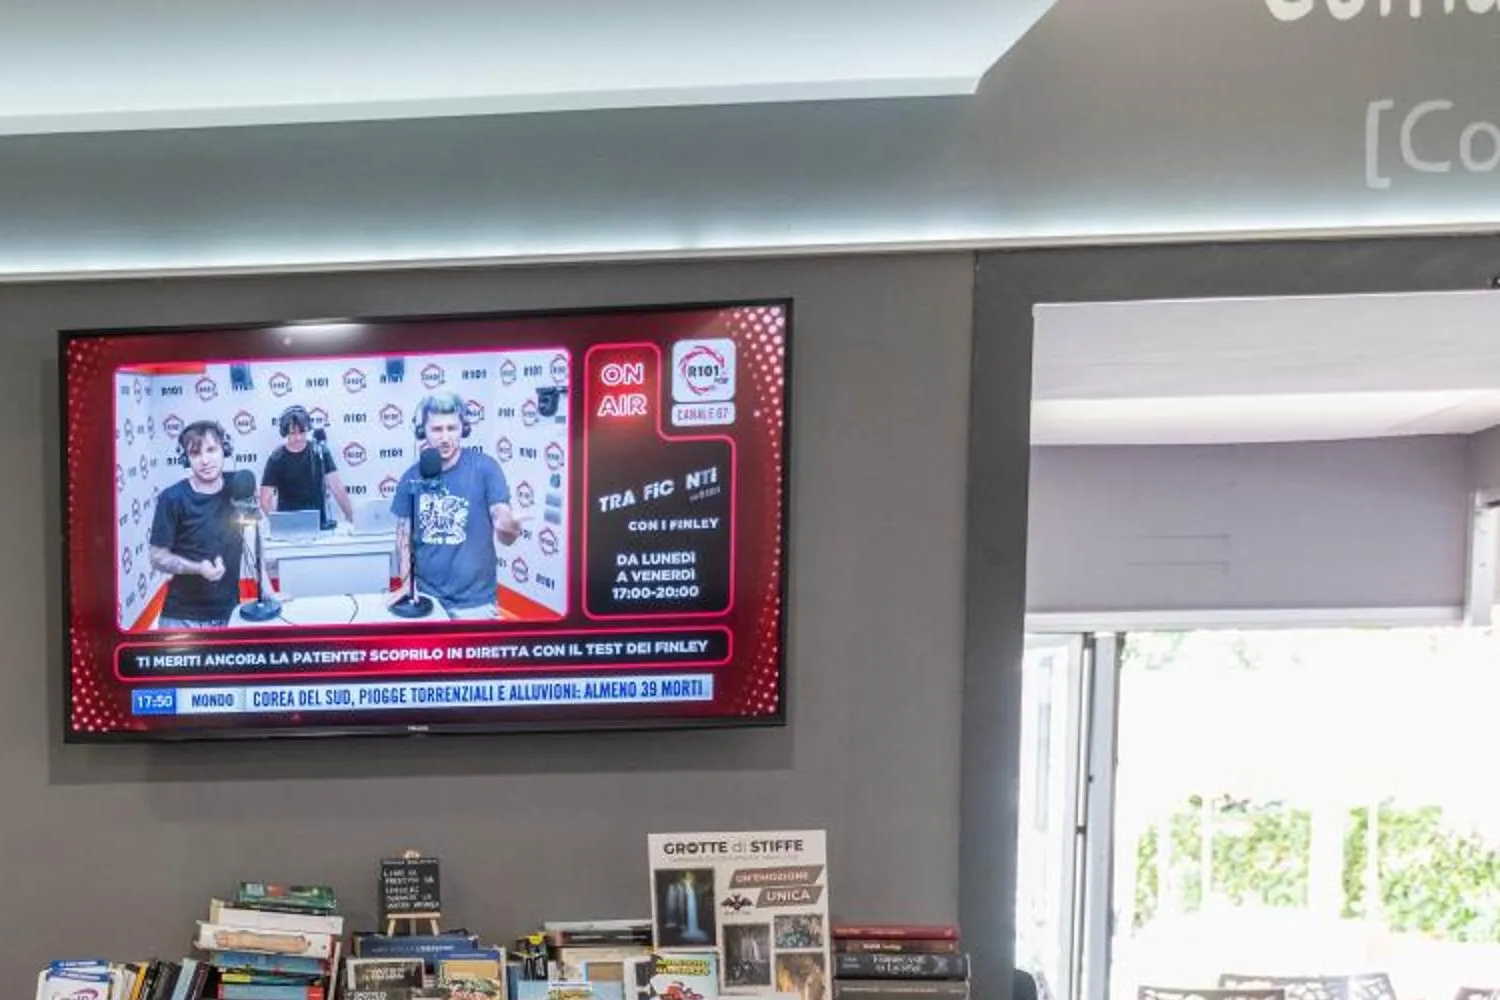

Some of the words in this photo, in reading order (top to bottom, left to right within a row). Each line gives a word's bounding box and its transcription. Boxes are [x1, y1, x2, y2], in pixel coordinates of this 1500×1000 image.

[601, 362, 644, 386] ON
[688, 366, 720, 378] R101
[597, 393, 647, 417] AIR
[598, 489, 636, 512] TRA
[628, 520, 658, 531] CON
[669, 517, 720, 531] FINLEY
[616, 553, 639, 566] DA
[641, 551, 696, 565] LUNEDÌ
[616, 571, 628, 583] A
[631, 569, 696, 582] VENERDÌ
[612, 585, 700, 600] 17:00-20:00
[136, 655, 150, 668] TI
[153, 654, 201, 668] MERITI
[205, 652, 266, 666] ANCORA
[270, 651, 290, 665] LA
[292, 649, 367, 664] PATENTE?
[369, 647, 443, 662] SCOPRILO
[447, 646, 463, 660] IN
[466, 644, 529, 659] DIRETTA
[532, 643, 566, 658] CON
[569, 643, 583, 656] IL
[586, 641, 621, 656] TEST
[626, 640, 651, 655] DEI
[655, 639, 709, 654] FINLEY
[137, 695, 173, 708] 17:50
[191, 692, 235, 707] MONDO
[253, 690, 295, 708] COREA
[299, 689, 322, 706] DEL
[325, 689, 355, 708] SUD,
[359, 688, 407, 705] PIOGGE
[411, 685, 493, 703] TORRENZIALI
[509, 683, 581, 701] ALLUVIONI:
[584, 681, 637, 699] ALMENO
[641, 681, 657, 698] 39
[661, 680, 703, 698] MORTI
[663, 841, 728, 855] GROTTE
[731, 841, 748, 854] di
[750, 839, 804, 853] STIFFE
[765, 889, 811, 902] UNICA
